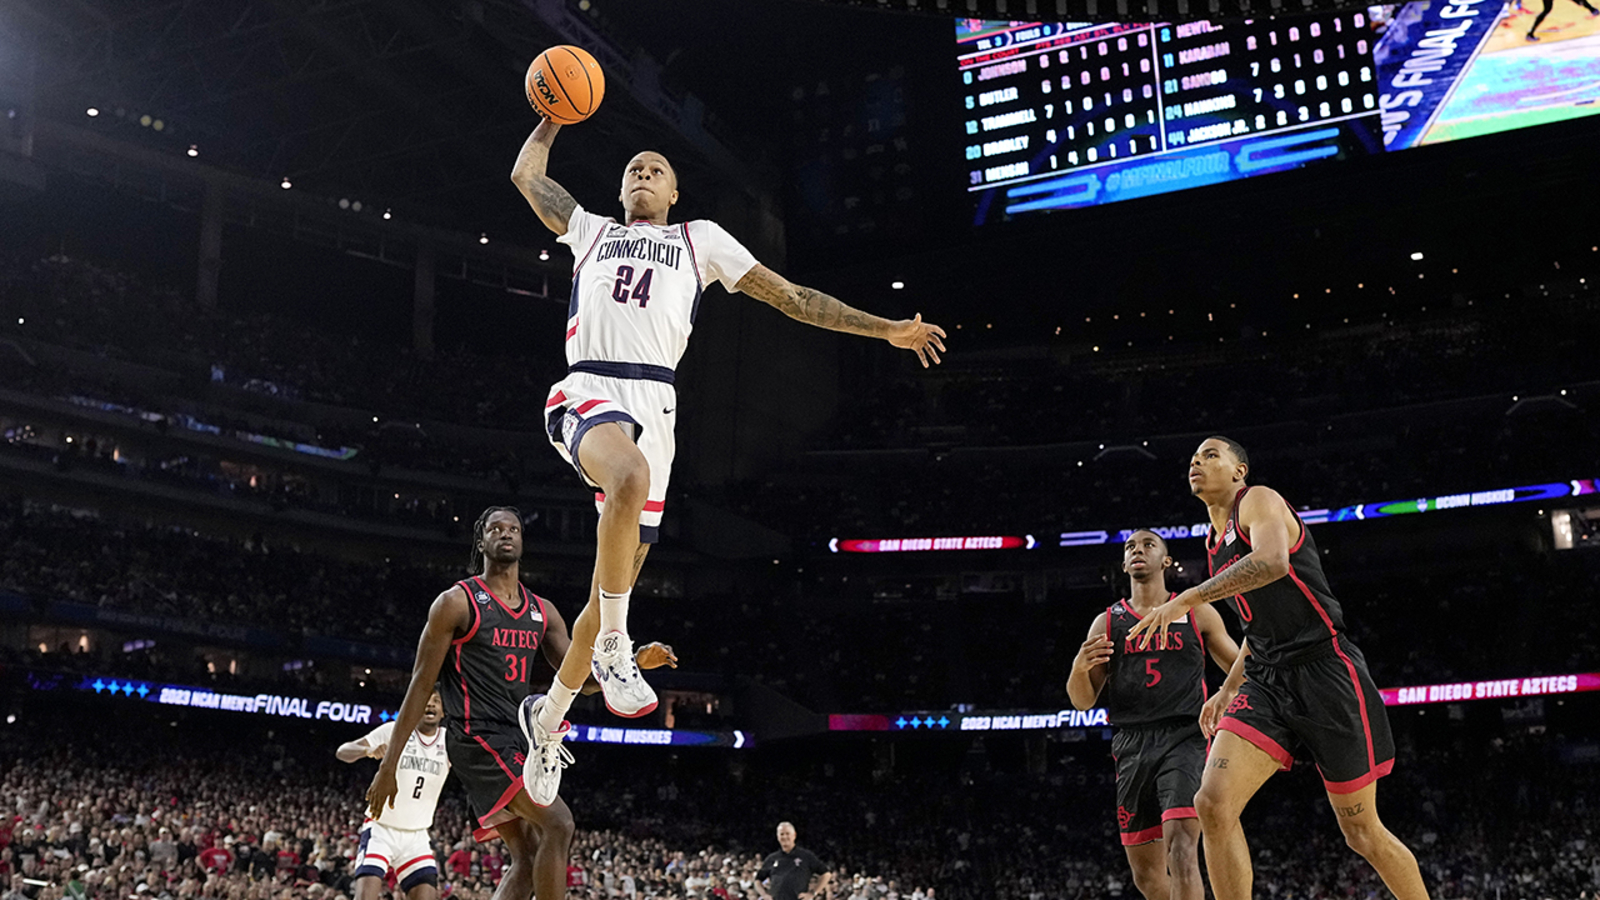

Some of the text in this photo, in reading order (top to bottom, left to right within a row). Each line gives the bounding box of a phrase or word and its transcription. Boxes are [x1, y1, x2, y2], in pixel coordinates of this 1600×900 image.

[1161, 28, 1171, 43] 2
[1391, 19, 1473, 88] FINAL
[534, 69, 560, 106] NCAA
[979, 87, 1019, 107] BUTLER
[596, 237, 683, 271] CONNECTICUT
[612, 265, 654, 309] 24
[933, 537, 964, 550] STATE
[964, 536, 1003, 550] AZTECS
[491, 627, 538, 650] AZTECS
[505, 653, 527, 683] 31
[1145, 658, 1162, 688] 5
[1397, 675, 1578, 704] SAN DIEGO STATE AZTECS
[159, 687, 191, 706] 2023
[191, 691, 220, 709] NCAA
[253, 694, 313, 718] FINAL
[315, 700, 372, 724] FOUR
[624, 729, 672, 745] HUSKIES
[960, 716, 991, 730] 2023
[991, 716, 1021, 730] NCAA
[412, 775, 425, 799] 2
